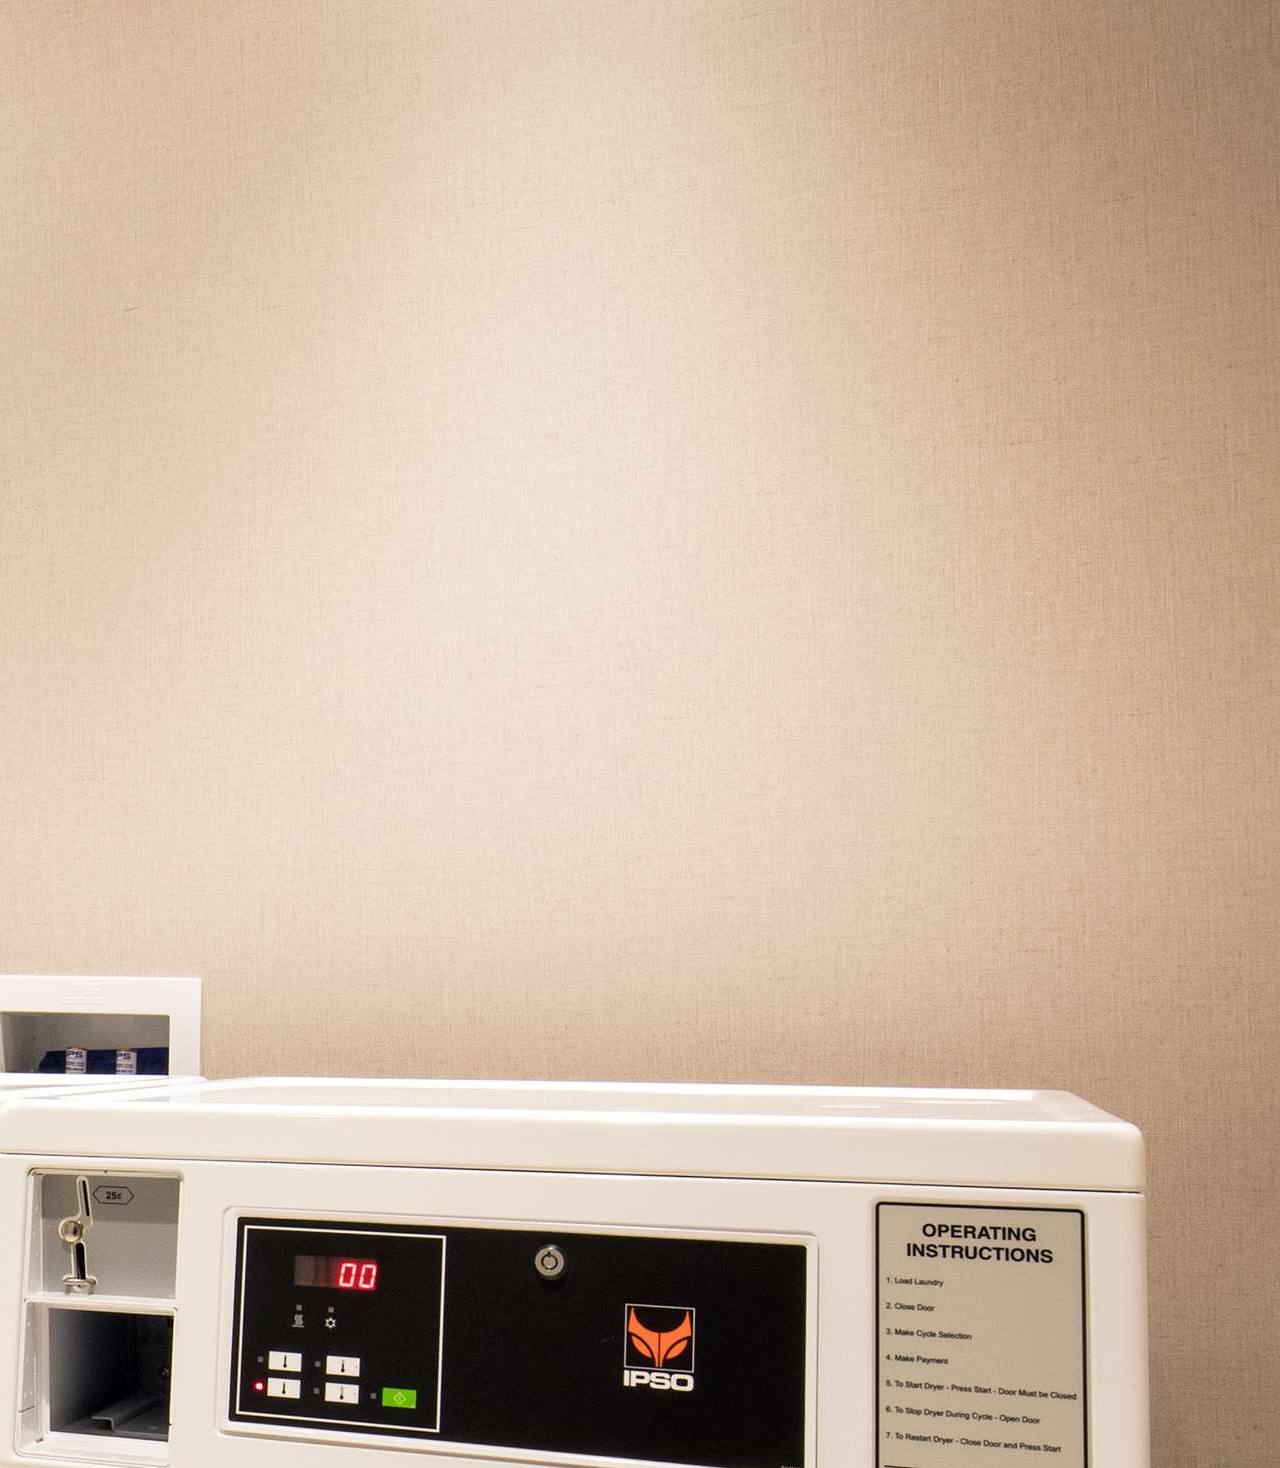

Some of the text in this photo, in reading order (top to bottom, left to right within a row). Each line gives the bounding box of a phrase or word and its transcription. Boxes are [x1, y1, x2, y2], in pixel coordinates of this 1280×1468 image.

[922, 1224, 1037, 1241] OPERATING
[907, 1243, 1053, 1263] INSTRUCTIONS
[339, 1264, 377, 1288] 00
[894, 1277, 912, 1285] Load
[914, 1278, 944, 1288] Laundry
[894, 1303, 915, 1311] Close
[917, 1304, 935, 1312] Door
[886, 1328, 972, 1340] 3. Make Cycle Selection
[894, 1354, 914, 1362] Make
[916, 1356, 949, 1365] Payment
[623, 1370, 694, 1392] IPSO
[886, 1380, 893, 1388] 5.
[924, 1383, 944, 1392] Dryer
[950, 1385, 972, 1393] Press
[973, 1386, 991, 1394] Start
[998, 1388, 1016, 1396] Door
[1018, 1389, 1036, 1397] Must
[1038, 1390, 1048, 1398] be
[1050, 1391, 1077, 1399] Closed
[905, 1408, 922, 1417] Stop
[923, 1409, 943, 1418] Dryer
[945, 1410, 970, 1420] During
[971, 1412, 993, 1421] Cycle
[999, 1414, 1020, 1423] Open
[1021, 1416, 1040, 1424] Door
[886, 1432, 893, 1440] 7.
[905, 1434, 931, 1442] Restart
[933, 1436, 953, 1445] Dryer
[959, 1438, 981, 1446] Close
[983, 1440, 1001, 1448] Door
[1019, 1442, 1041, 1450] Press
[1043, 1444, 1061, 1452] Start
